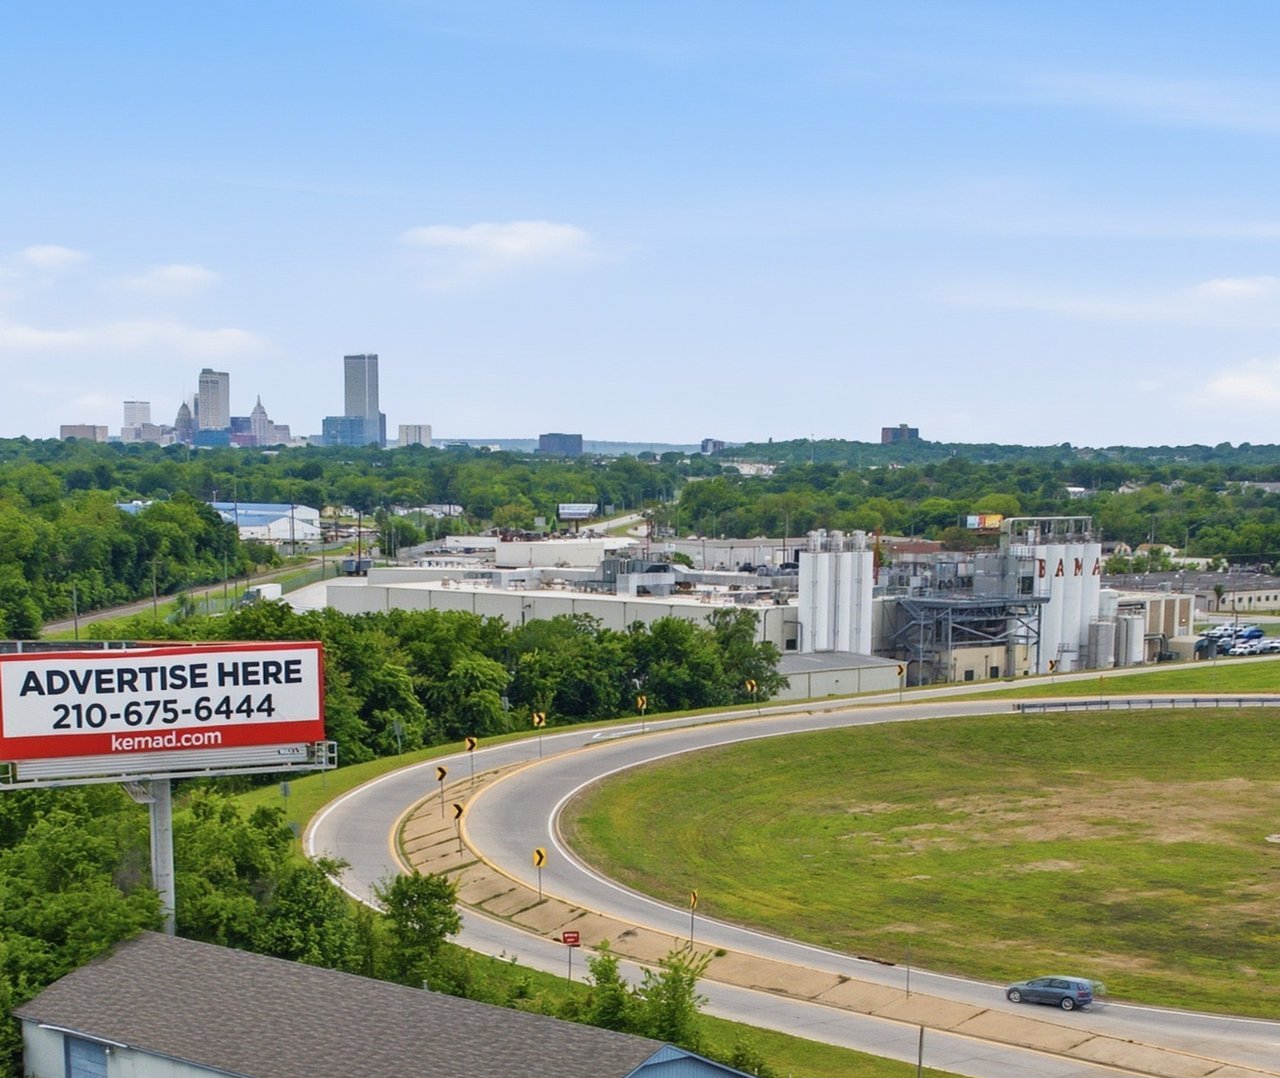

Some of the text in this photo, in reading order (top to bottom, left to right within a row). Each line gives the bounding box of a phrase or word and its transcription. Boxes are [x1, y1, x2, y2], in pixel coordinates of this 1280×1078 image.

[1038, 557, 1100, 578] BAMA
[19, 658, 303, 697] ADVERTISE HERE
[52, 692, 276, 730] 210-675-6444
[110, 730, 222, 752] kemad.com
